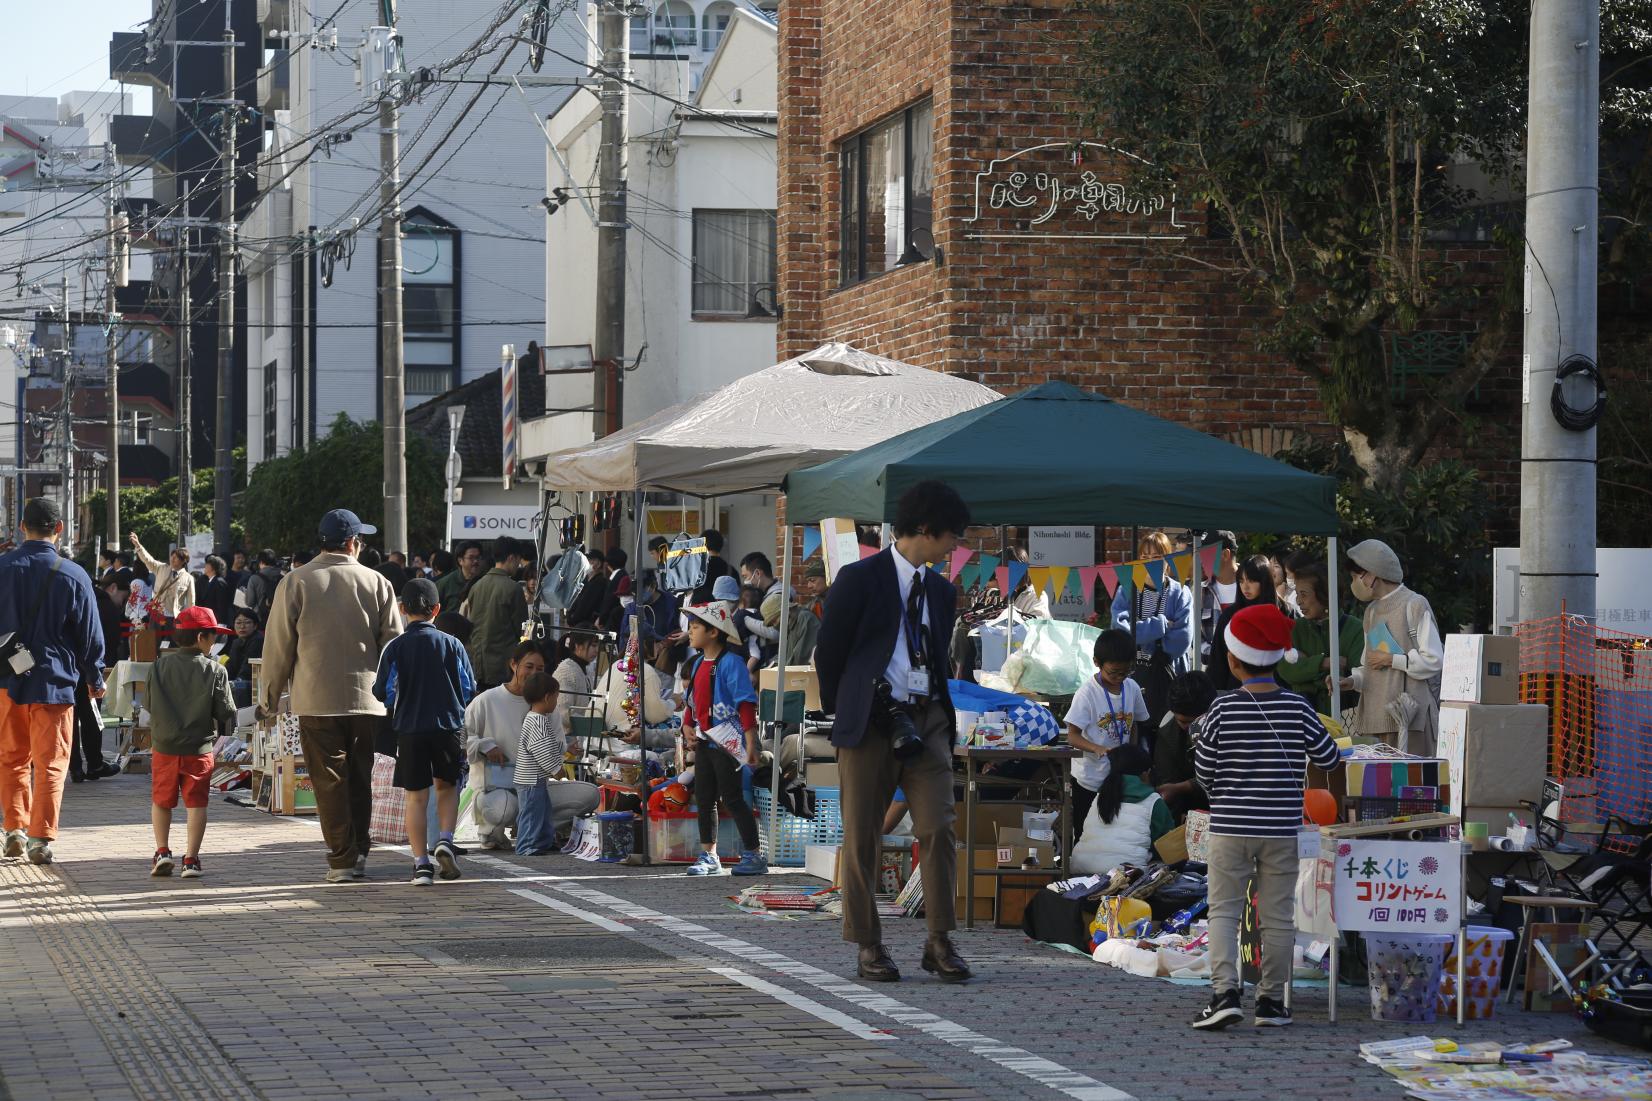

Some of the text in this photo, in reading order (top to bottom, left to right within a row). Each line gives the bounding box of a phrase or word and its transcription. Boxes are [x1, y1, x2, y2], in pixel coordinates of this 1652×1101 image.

[479, 517, 527, 529] SONIC
[1033, 530, 1092, 539] Nihonbashi Bldg.
[1343, 856, 1409, 879] 千本くじ
[1356, 882, 1446, 901] コリントゲーム
[1368, 907, 1427, 923] 1回 100円
